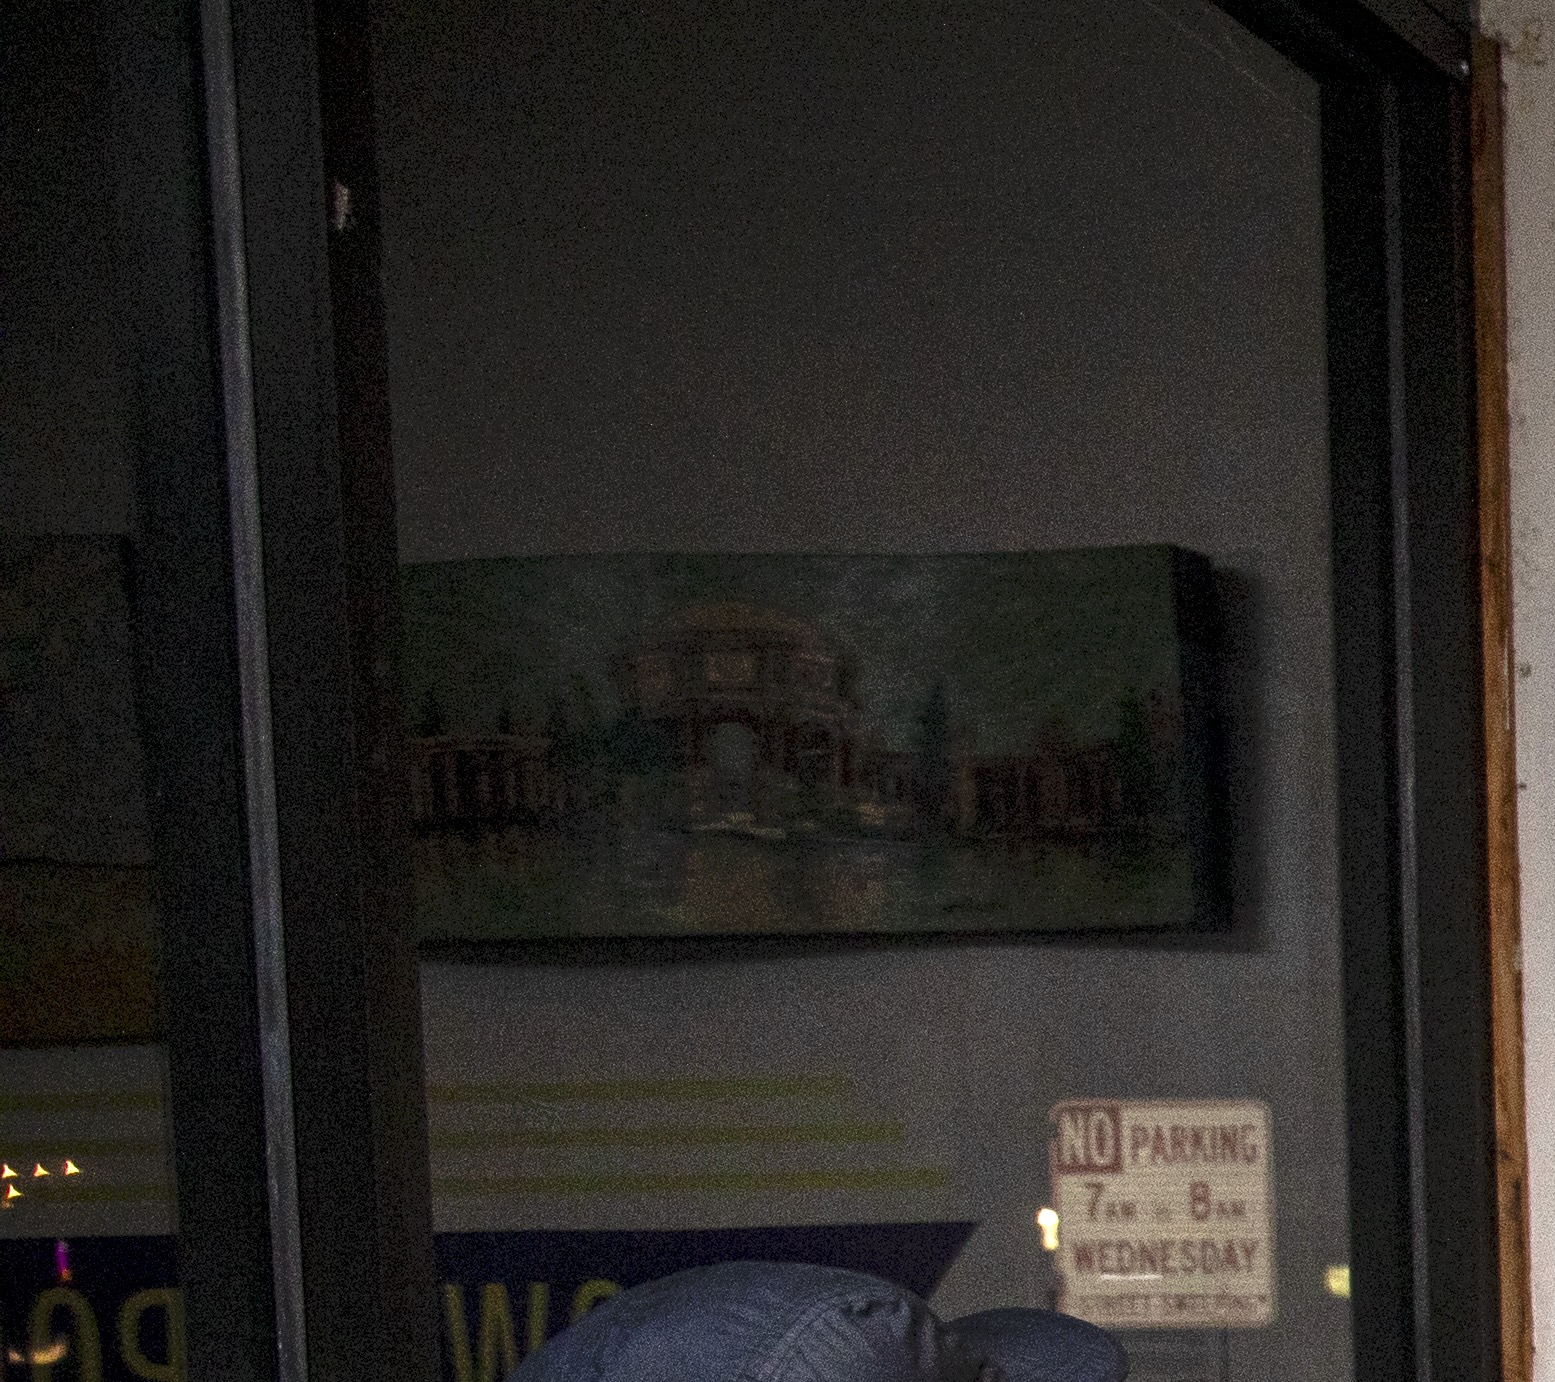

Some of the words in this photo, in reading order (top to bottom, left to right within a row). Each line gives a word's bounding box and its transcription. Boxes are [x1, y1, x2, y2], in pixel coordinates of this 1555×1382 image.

[1061, 1110, 1114, 1166] NO
[1130, 1124, 1259, 1165] PARKING
[1073, 1239, 1259, 1274] WEDNESDAY
